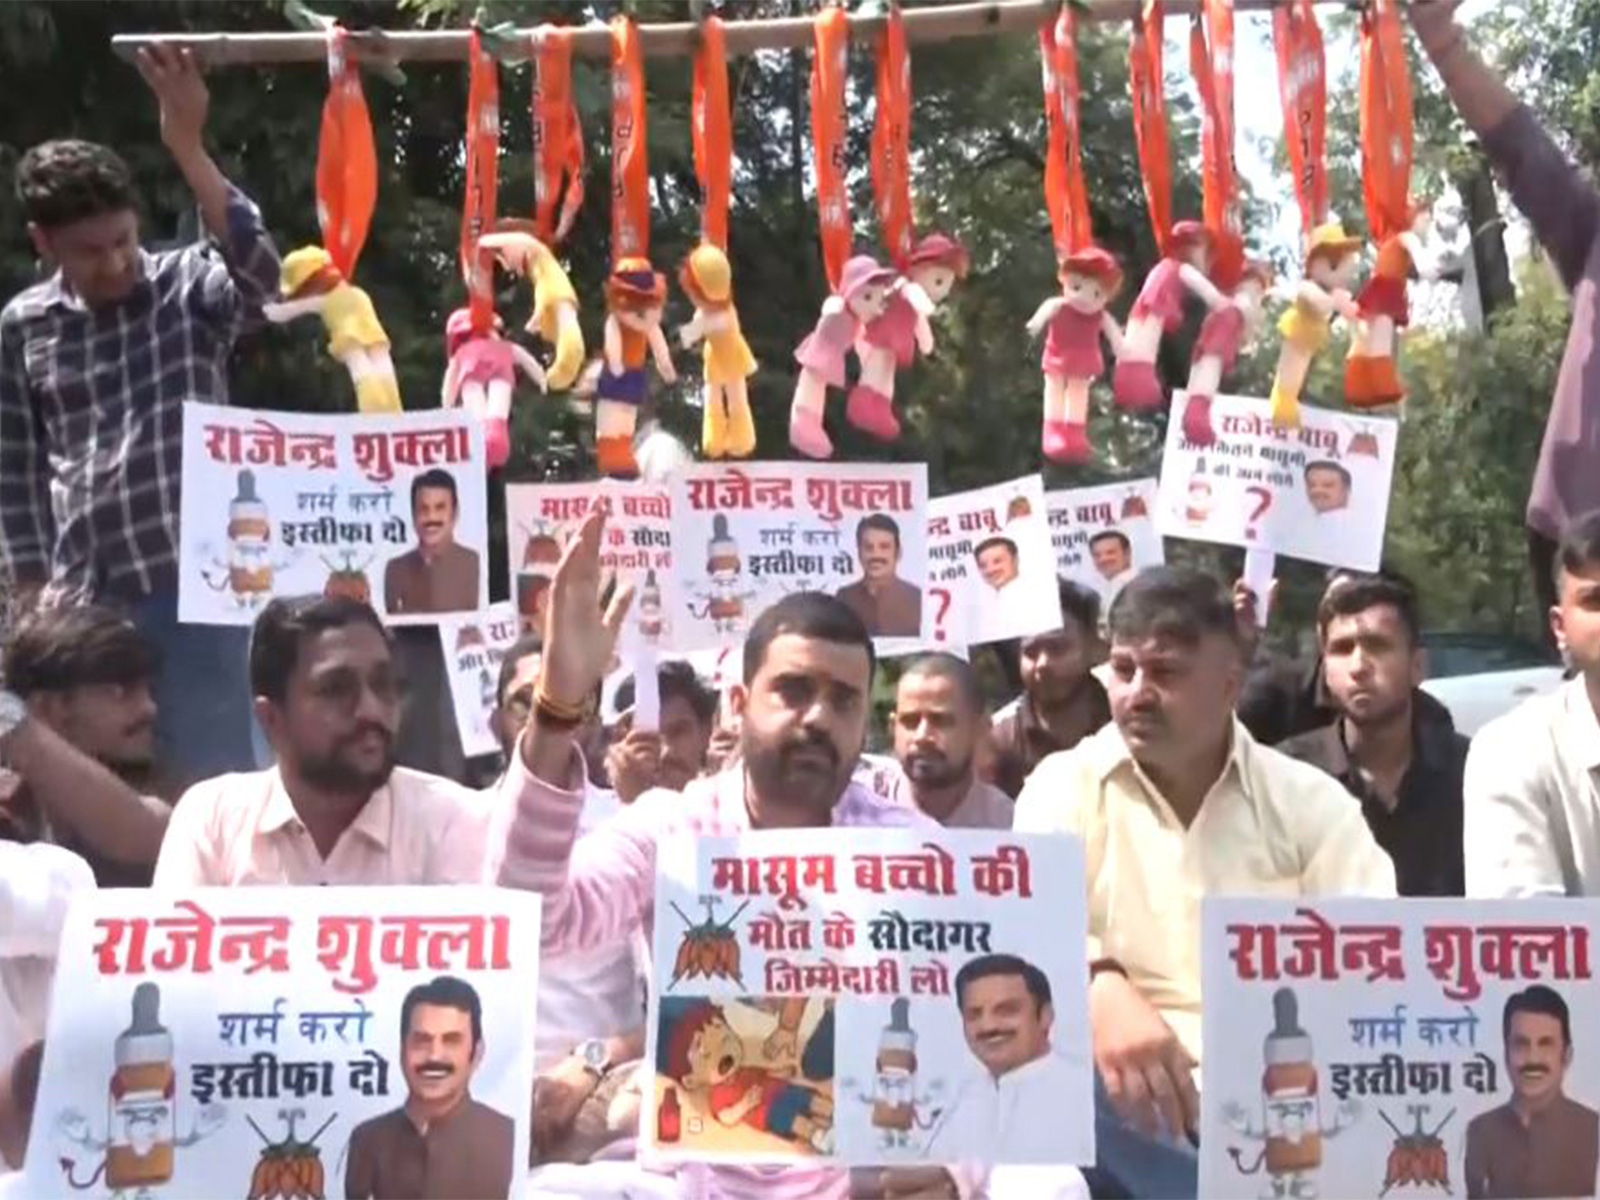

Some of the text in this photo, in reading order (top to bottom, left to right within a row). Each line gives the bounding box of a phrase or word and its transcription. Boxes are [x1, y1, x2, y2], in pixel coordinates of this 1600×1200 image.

[203, 418, 471, 482] राजेन्द्र शुक्ला
[297, 484, 394, 513] शर्म करो
[685, 467, 913, 522] राजेन्द्र शुक्ला
[281, 515, 407, 547] इस्तीफा दो
[759, 520, 796, 547] शर्म
[748, 549, 853, 576] इस्तीफा दो
[711, 842, 1032, 911] मासूम बच्चो की
[92, 899, 512, 994] राजेन्द्र शुक्ला
[748, 910, 992, 953] मौत के सौदागर
[1226, 908, 1592, 1000] राजेन्द्र शुक्ला
[764, 958, 951, 996] जिम्मेदारी लो
[217, 998, 373, 1045] शर्म करो
[1348, 1004, 1480, 1048] शर्म करो
[189, 1050, 390, 1104] इस्तीफा दो
[1329, 1053, 1498, 1100] इस्तीफा दो
